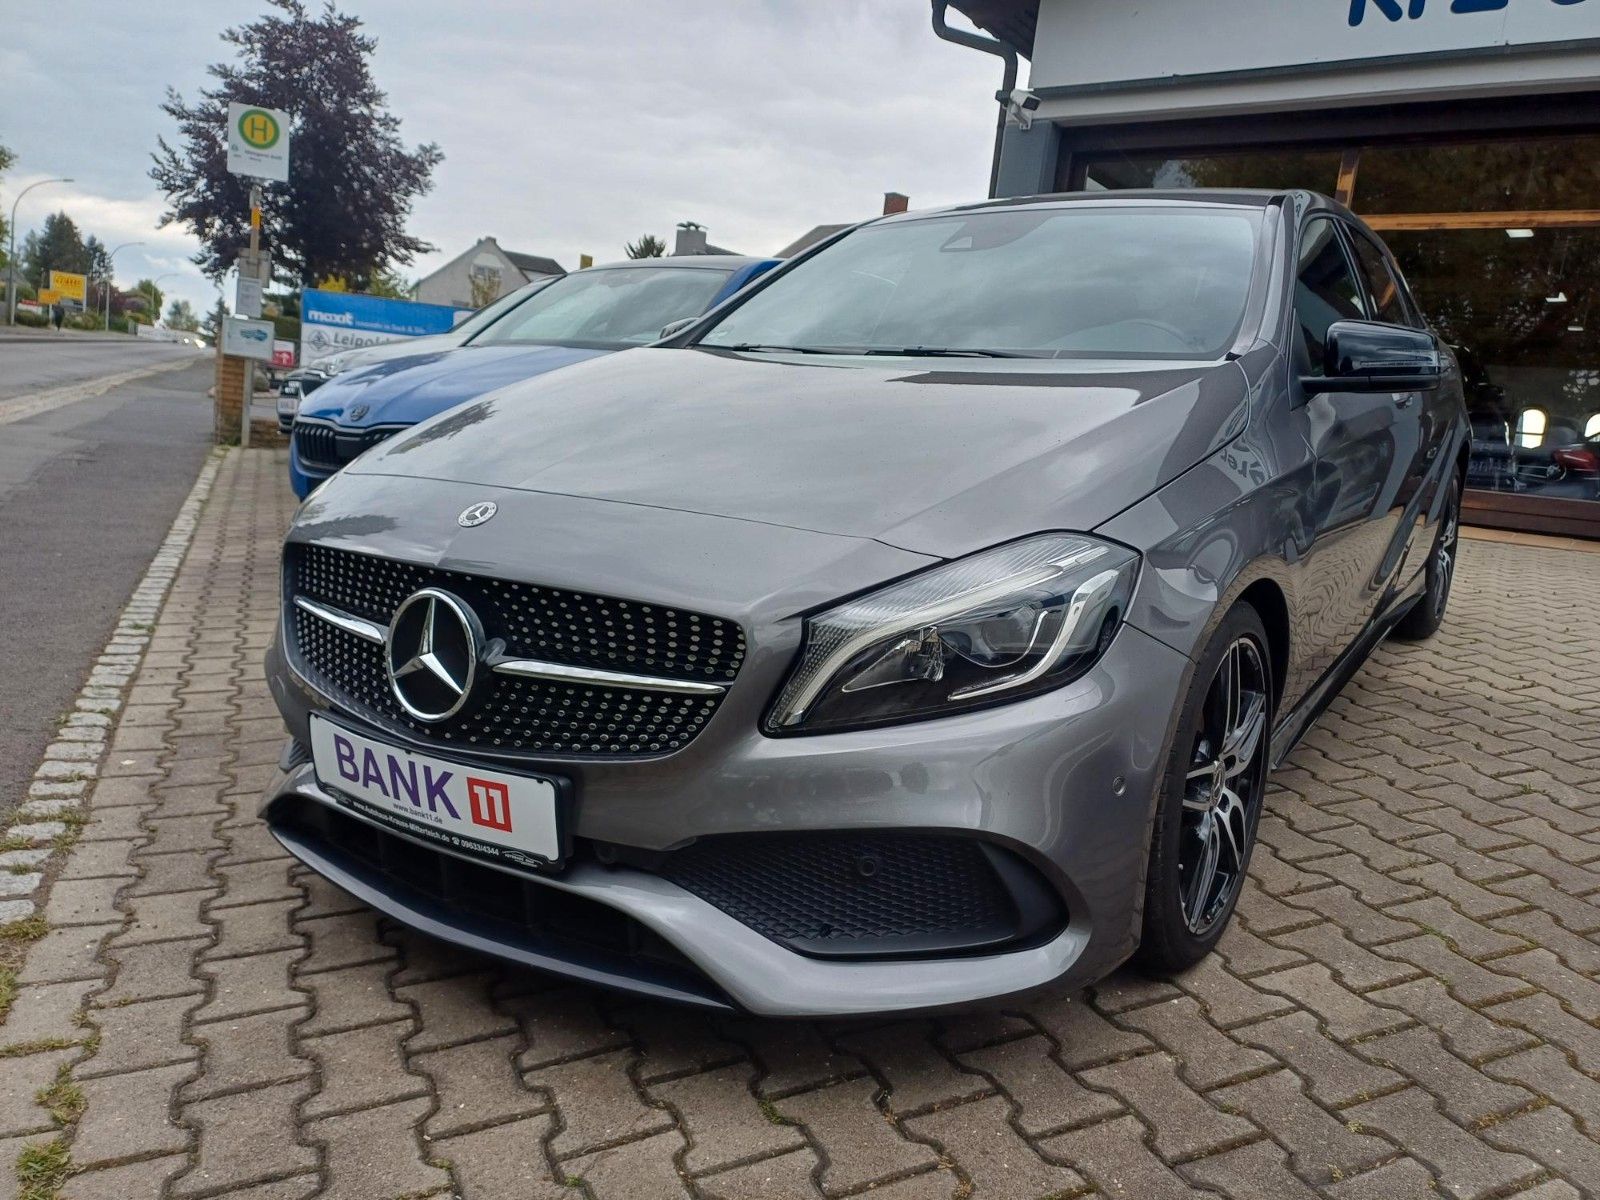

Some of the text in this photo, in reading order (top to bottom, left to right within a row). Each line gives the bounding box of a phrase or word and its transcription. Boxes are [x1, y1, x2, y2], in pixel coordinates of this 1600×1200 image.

[250, 116, 268, 142] H
[333, 733, 506, 825] BANK 11
[393, 803, 443, 825] www.bank11.de
